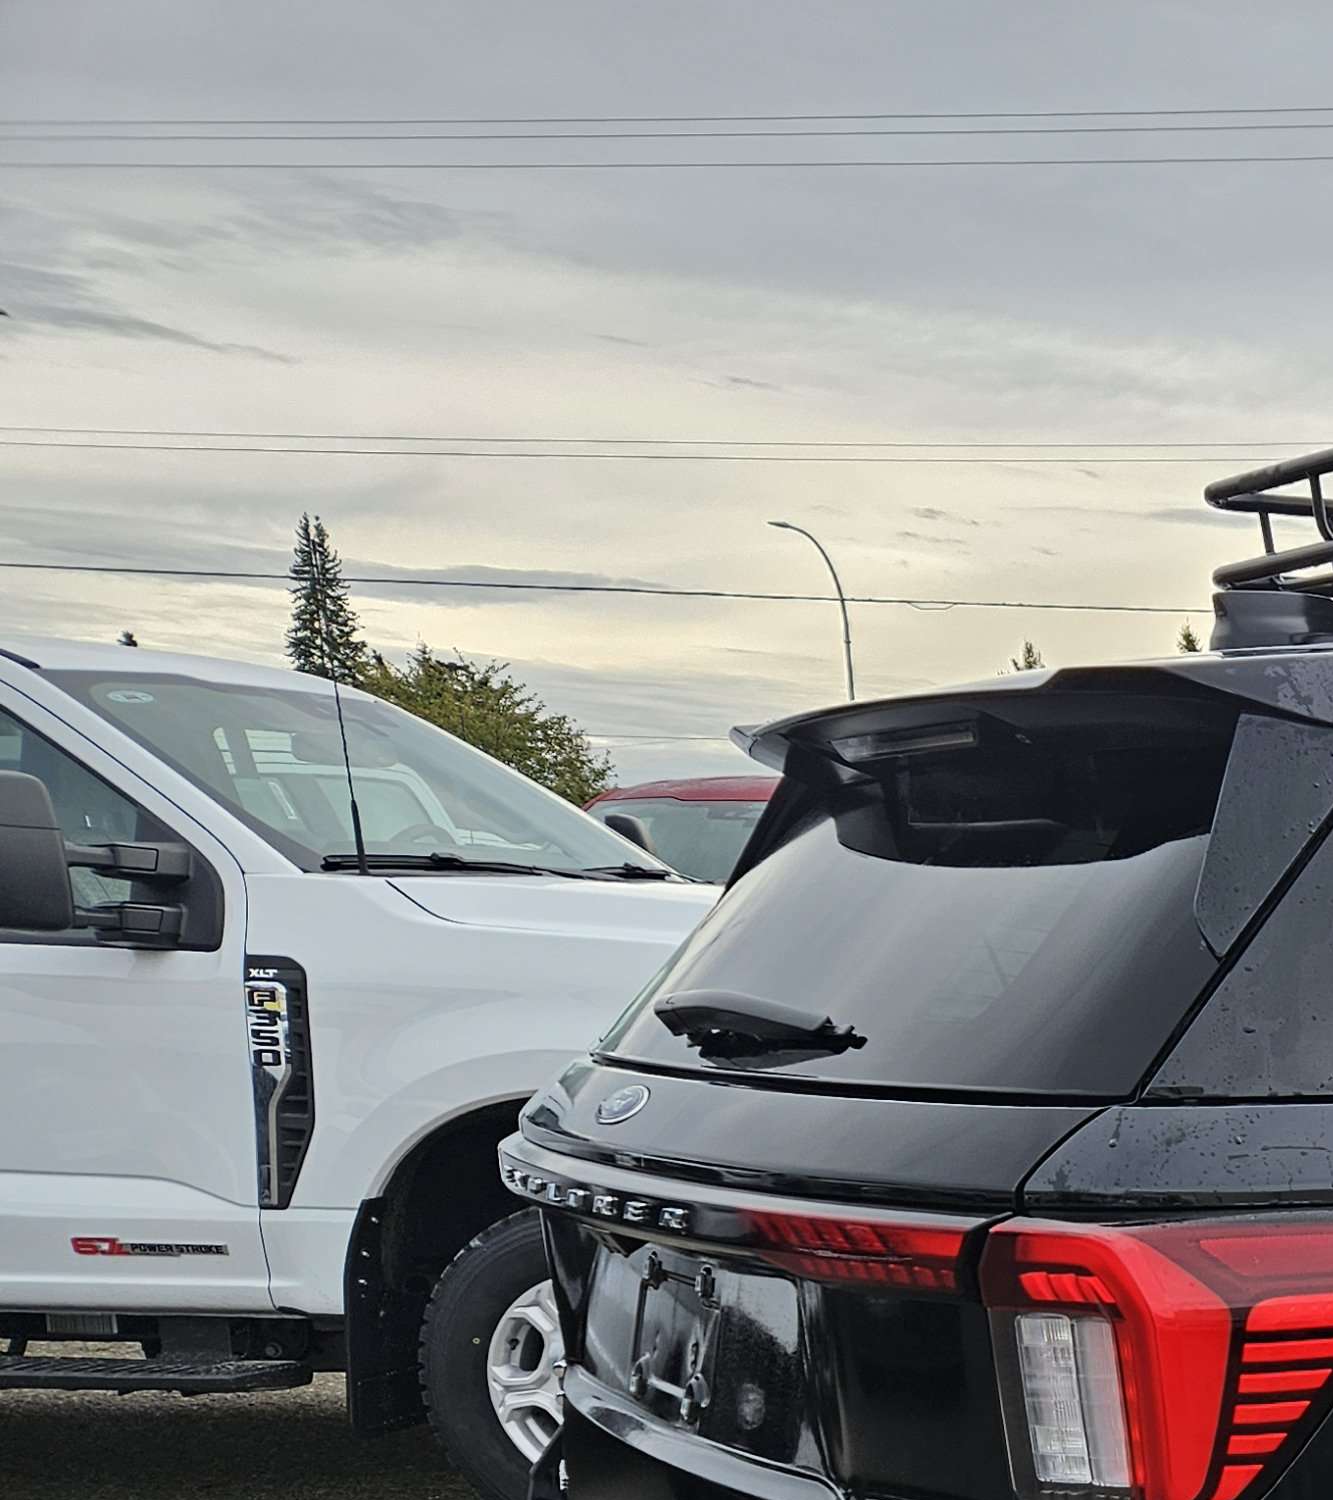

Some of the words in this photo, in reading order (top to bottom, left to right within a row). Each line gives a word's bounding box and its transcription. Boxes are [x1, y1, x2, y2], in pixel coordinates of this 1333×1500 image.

[248, 968, 278, 978] XLT
[130, 1243, 175, 1254] POWER
[175, 1244, 225, 1256] STROKE
